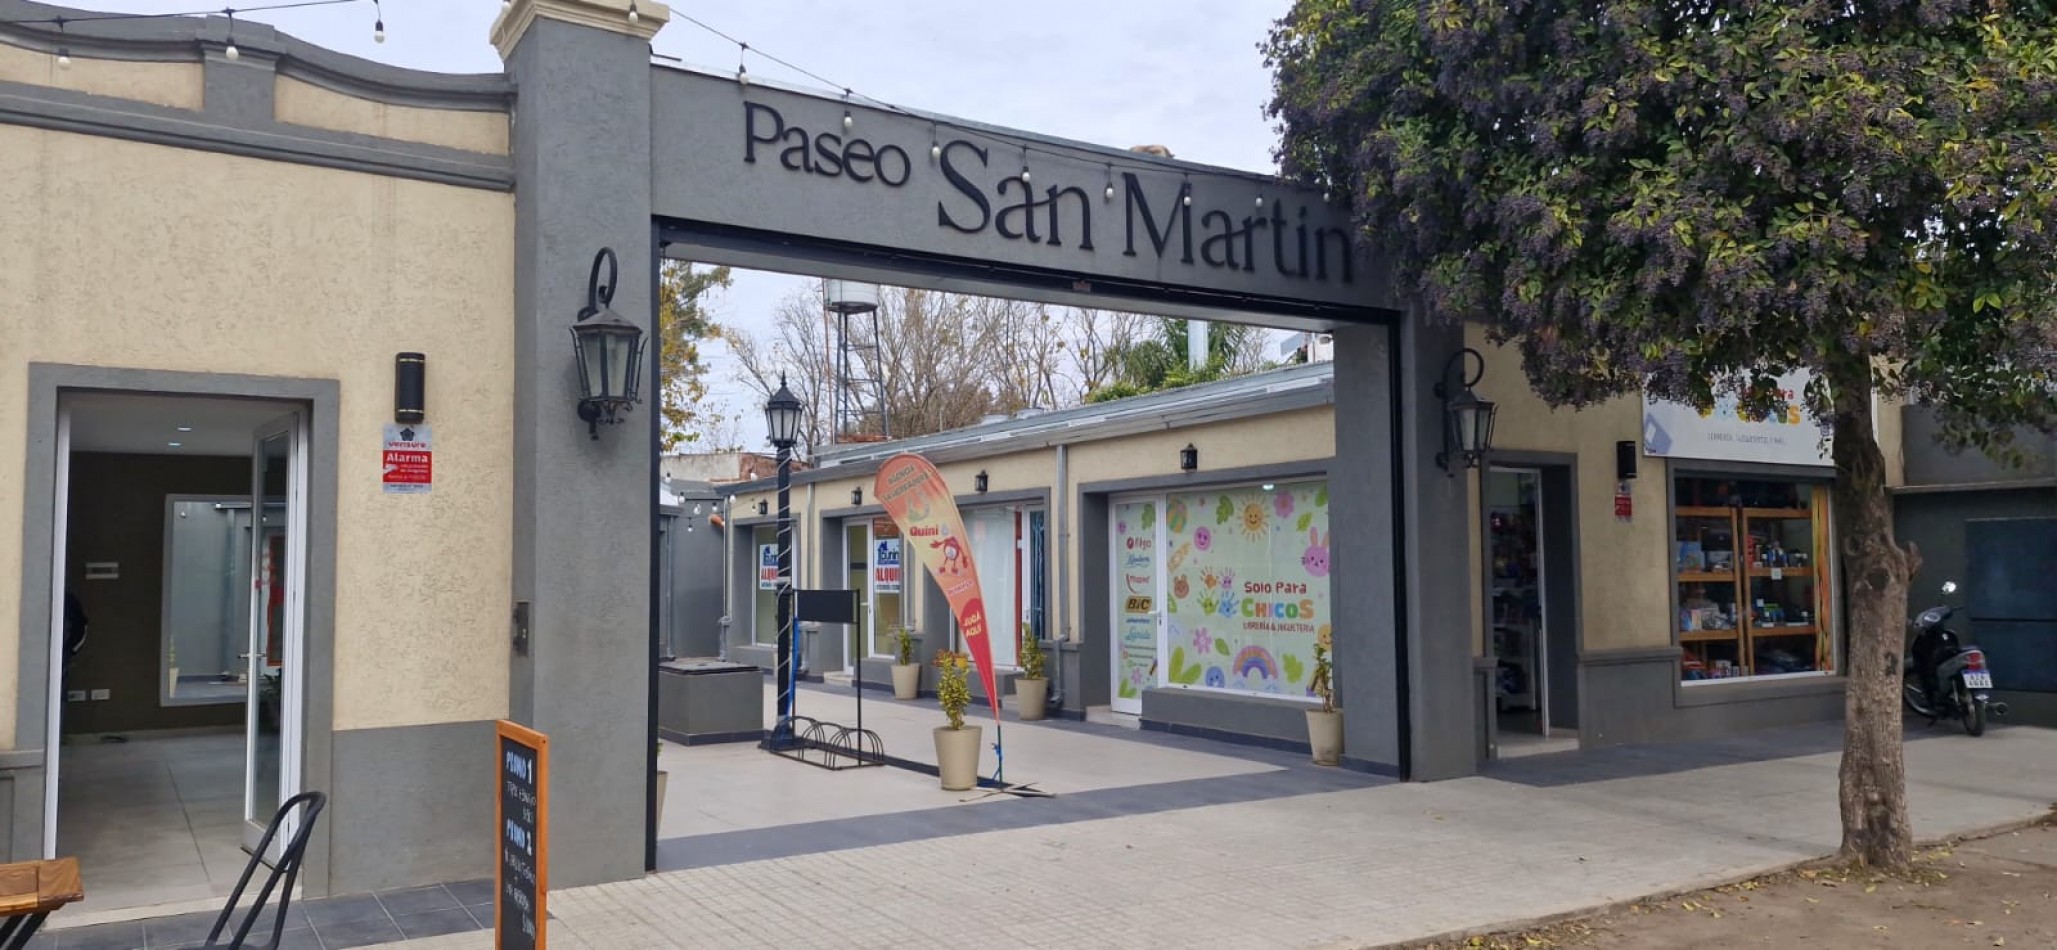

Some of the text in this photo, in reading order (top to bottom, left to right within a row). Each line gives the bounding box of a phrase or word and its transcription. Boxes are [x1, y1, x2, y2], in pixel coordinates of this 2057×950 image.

[743, 100, 911, 187] Paseo
[938, 140, 1094, 251] San
[386, 452, 428, 463] Alarma
[910, 524, 938, 537] Quini
[1244, 581, 1307, 595] Solo Para
